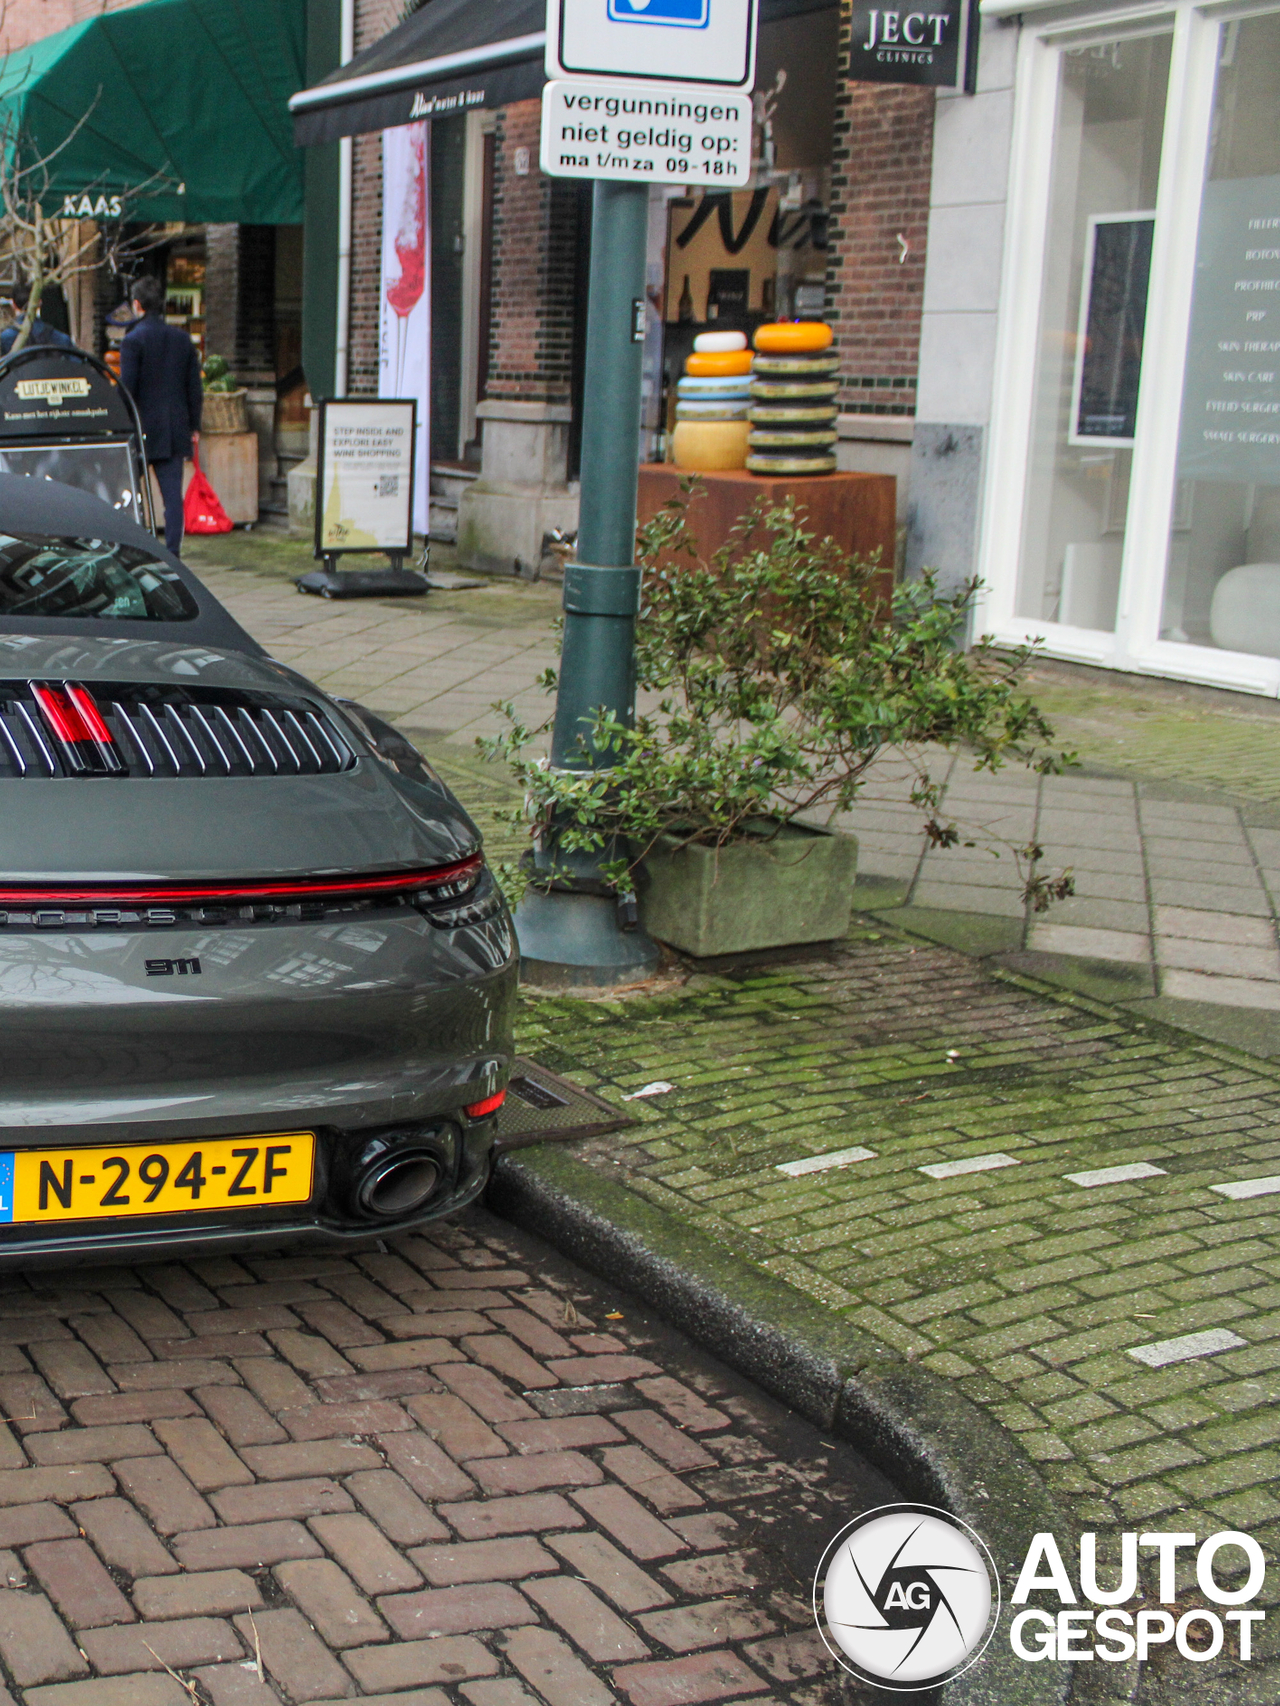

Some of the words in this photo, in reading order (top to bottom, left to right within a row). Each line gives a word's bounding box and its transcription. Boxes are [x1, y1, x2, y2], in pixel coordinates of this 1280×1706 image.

[863, 10, 950, 51] JECT
[876, 50, 934, 65] CLINICS
[563, 93, 740, 124] vergunningen
[561, 122, 609, 143] niet
[617, 127, 693, 154] geldig
[700, 135, 739, 155] op:
[559, 153, 589, 167] ma
[596, 153, 629, 169] t/m
[632, 159, 654, 171] za
[666, 158, 738, 176] 09-18h
[63, 194, 122, 217] KAAS
[1218, 341, 1240, 352] SKIN
[1223, 371, 1245, 382] SKIN
[1248, 371, 1275, 383] CARE
[22, 380, 85, 396] LUTJEWINKEL
[334, 426, 354, 436] STEP
[356, 426, 383, 436] INSIDE
[385, 426, 404, 436] AND
[333, 437, 369, 447] EXPLORE
[372, 437, 394, 447] EASY
[333, 448, 355, 458] WINE
[357, 448, 402, 458] SHOPPING
[144, 957, 202, 976] 911
[38, 1145, 292, 1211] N-294-ZF
